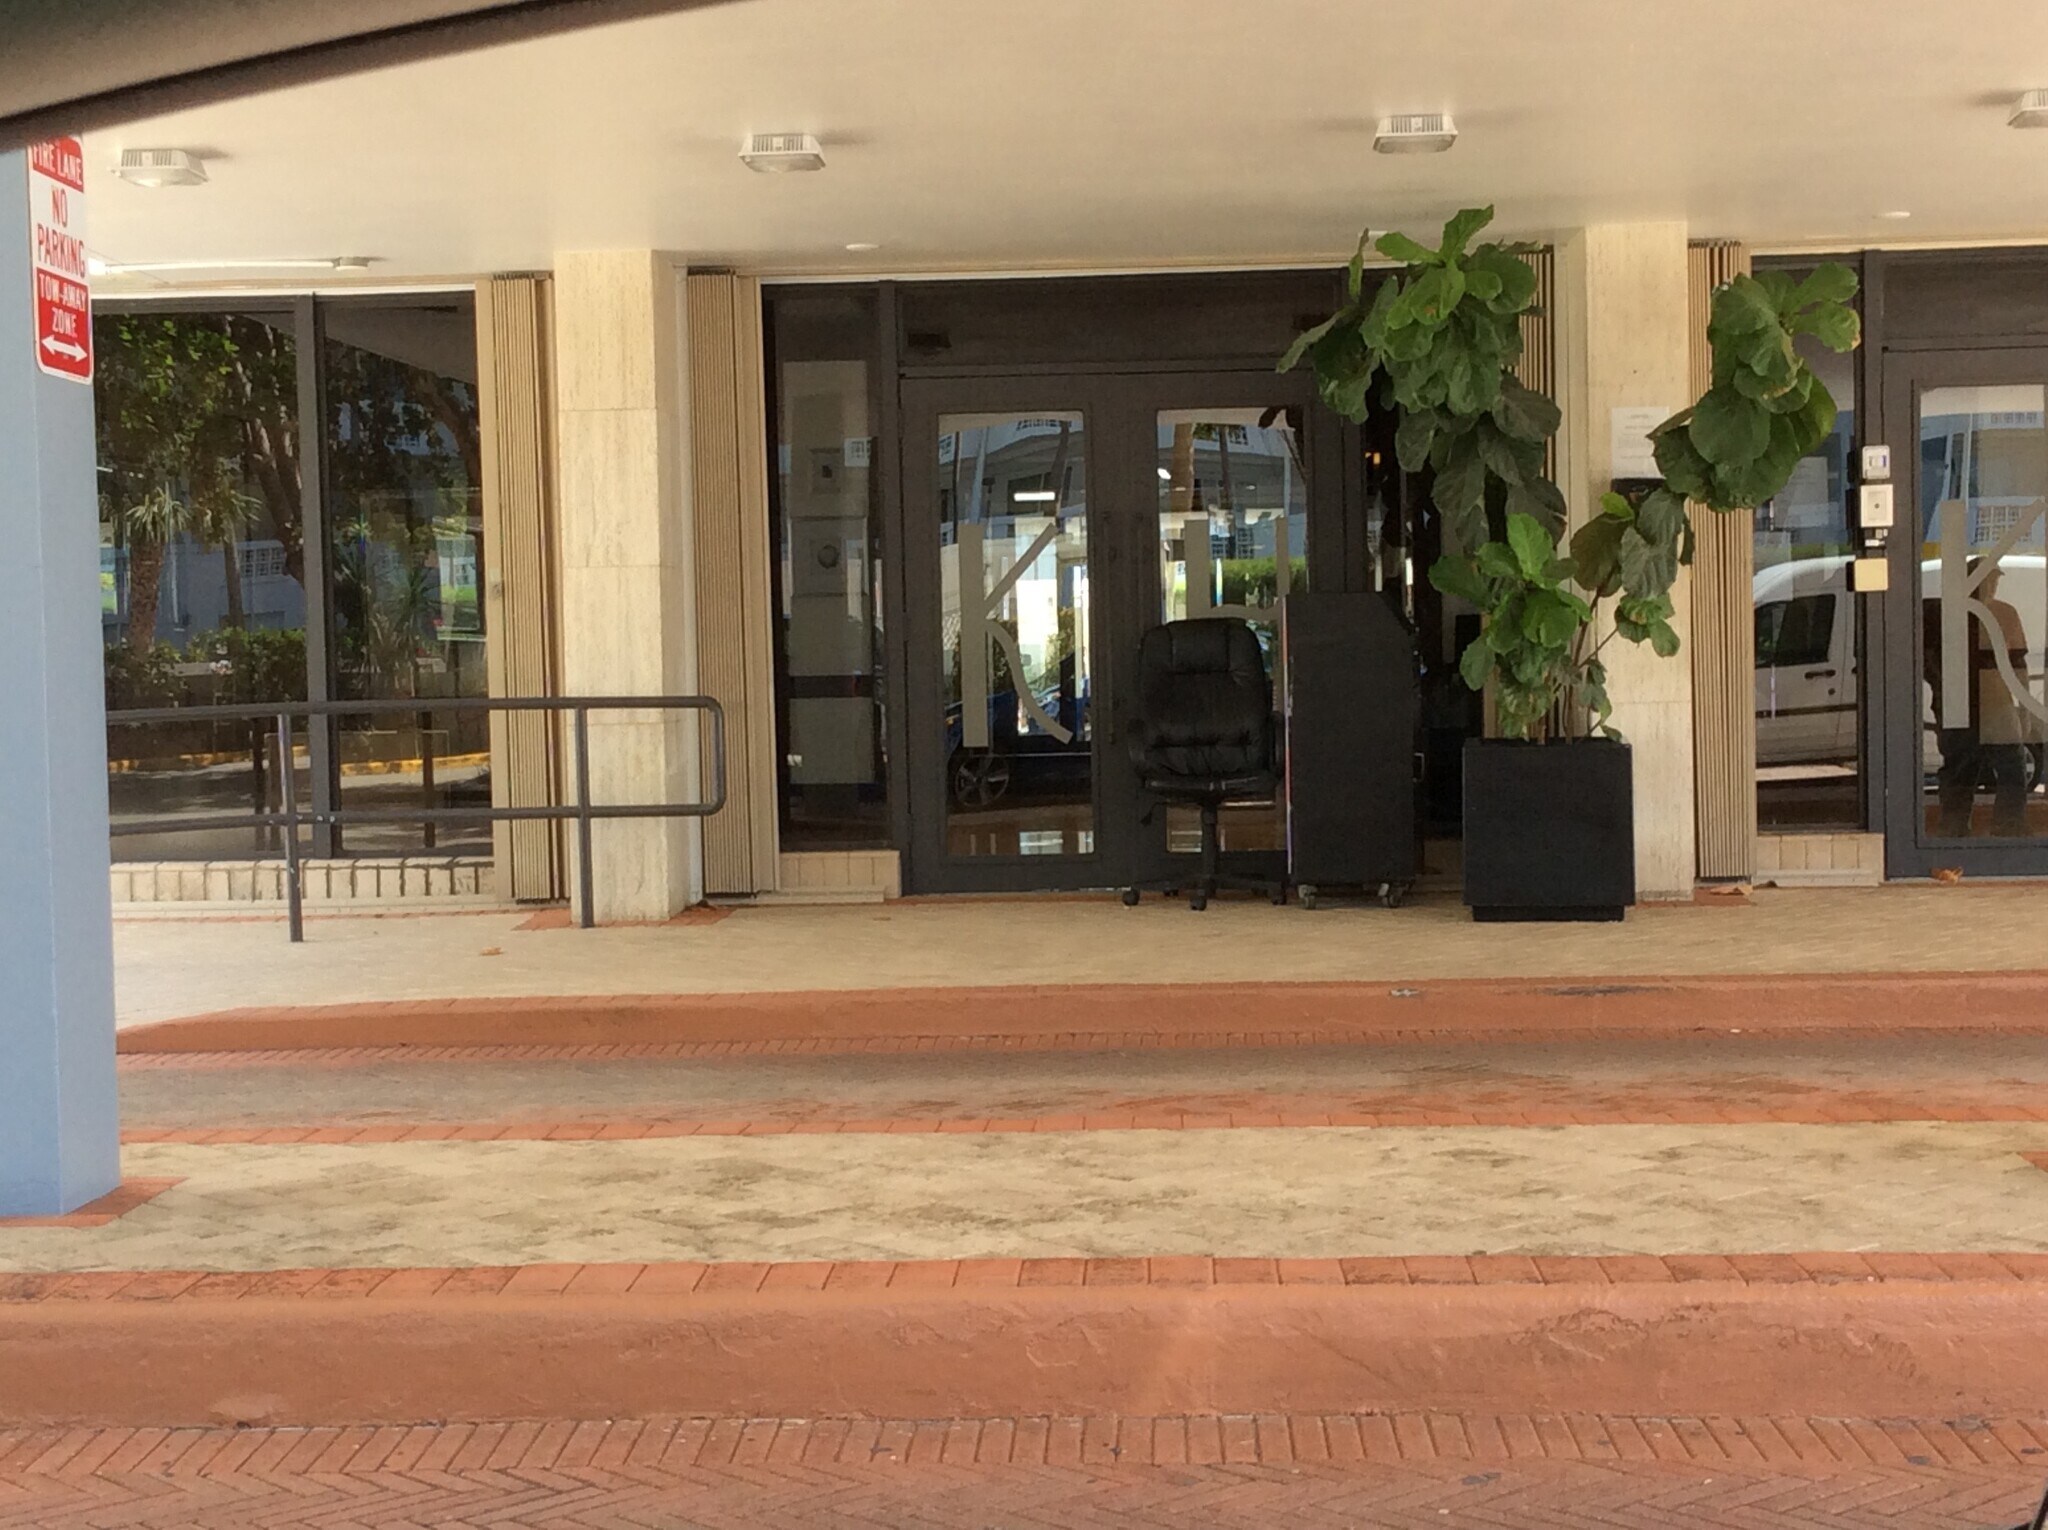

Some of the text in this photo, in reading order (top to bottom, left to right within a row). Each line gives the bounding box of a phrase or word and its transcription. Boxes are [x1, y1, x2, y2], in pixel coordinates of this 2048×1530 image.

[33, 142, 83, 186] FIRE LANE
[51, 186, 68, 228] NO
[37, 223, 86, 279] PARKING
[39, 273, 87, 312] TOW-AWAY
[51, 306, 78, 338] ZONE
